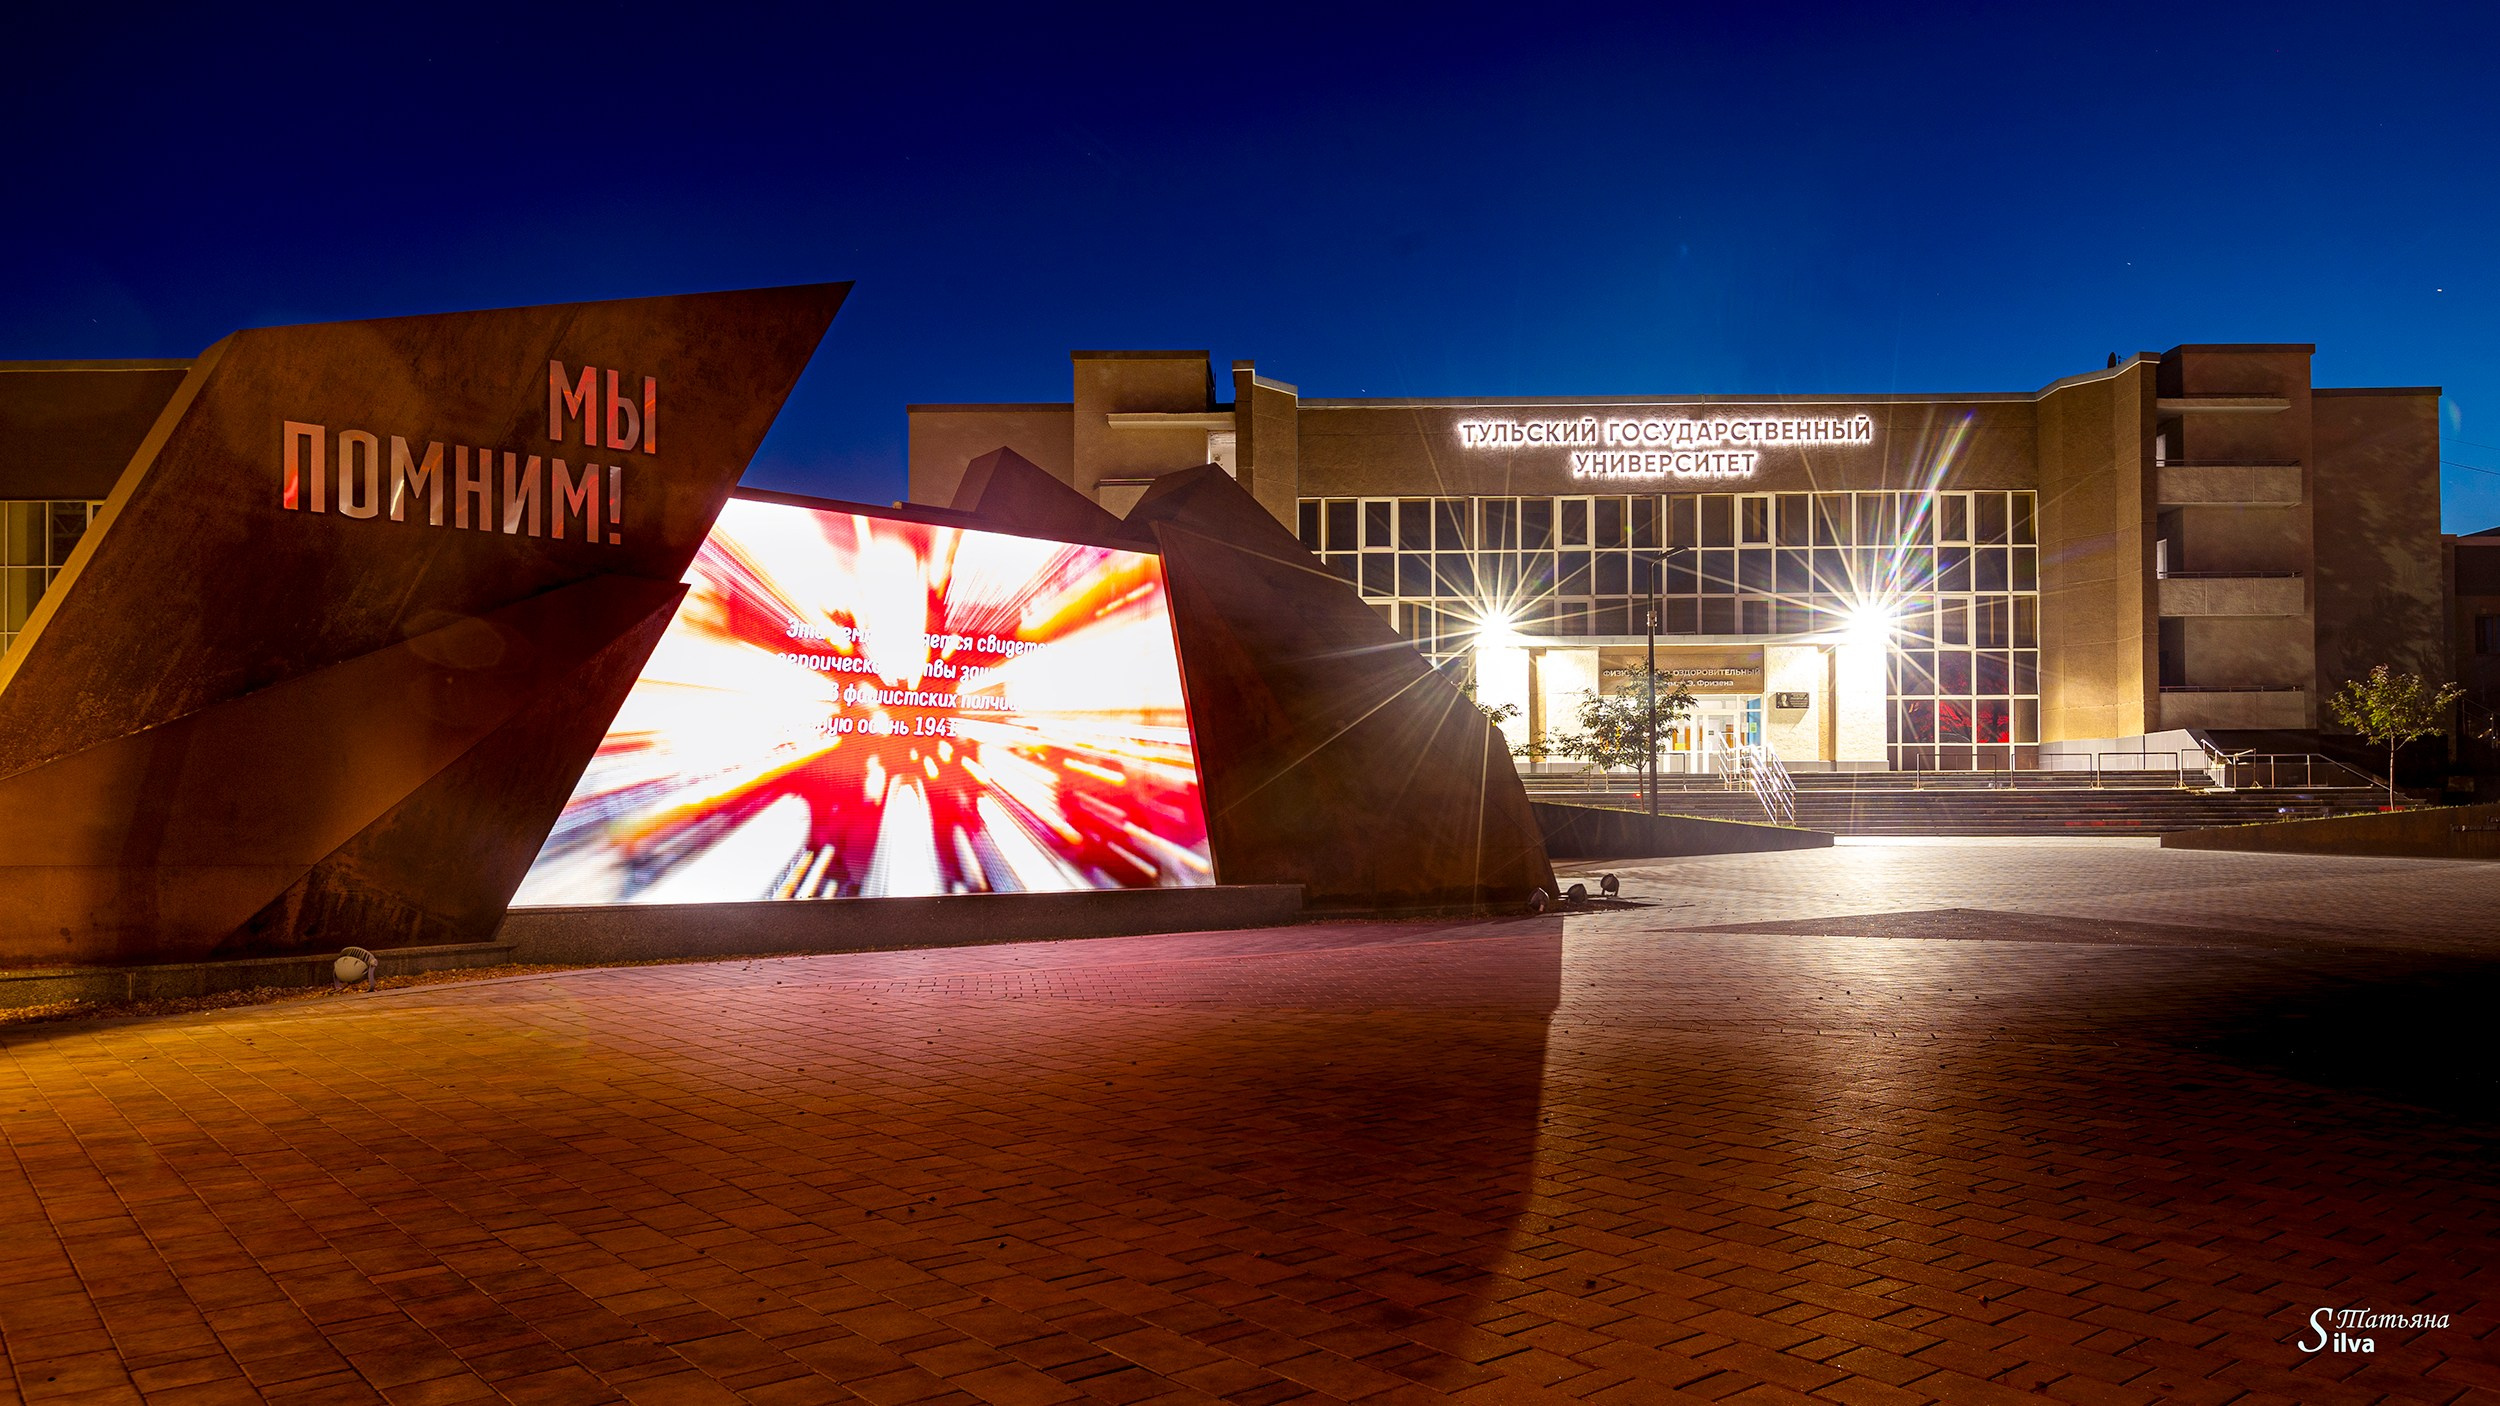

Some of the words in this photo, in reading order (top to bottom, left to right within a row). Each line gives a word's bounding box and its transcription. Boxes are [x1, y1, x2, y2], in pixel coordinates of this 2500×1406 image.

[549, 359, 656, 455] МЫ
[1462, 417, 1597, 443] ТУЛЬСКИЙ
[1608, 416, 1872, 444] ГОСУДАРСТВЕННЫЙ
[283, 420, 622, 545] ПОМНИМ!
[1575, 453, 1757, 474] УНИВЕРСИТЕТ
